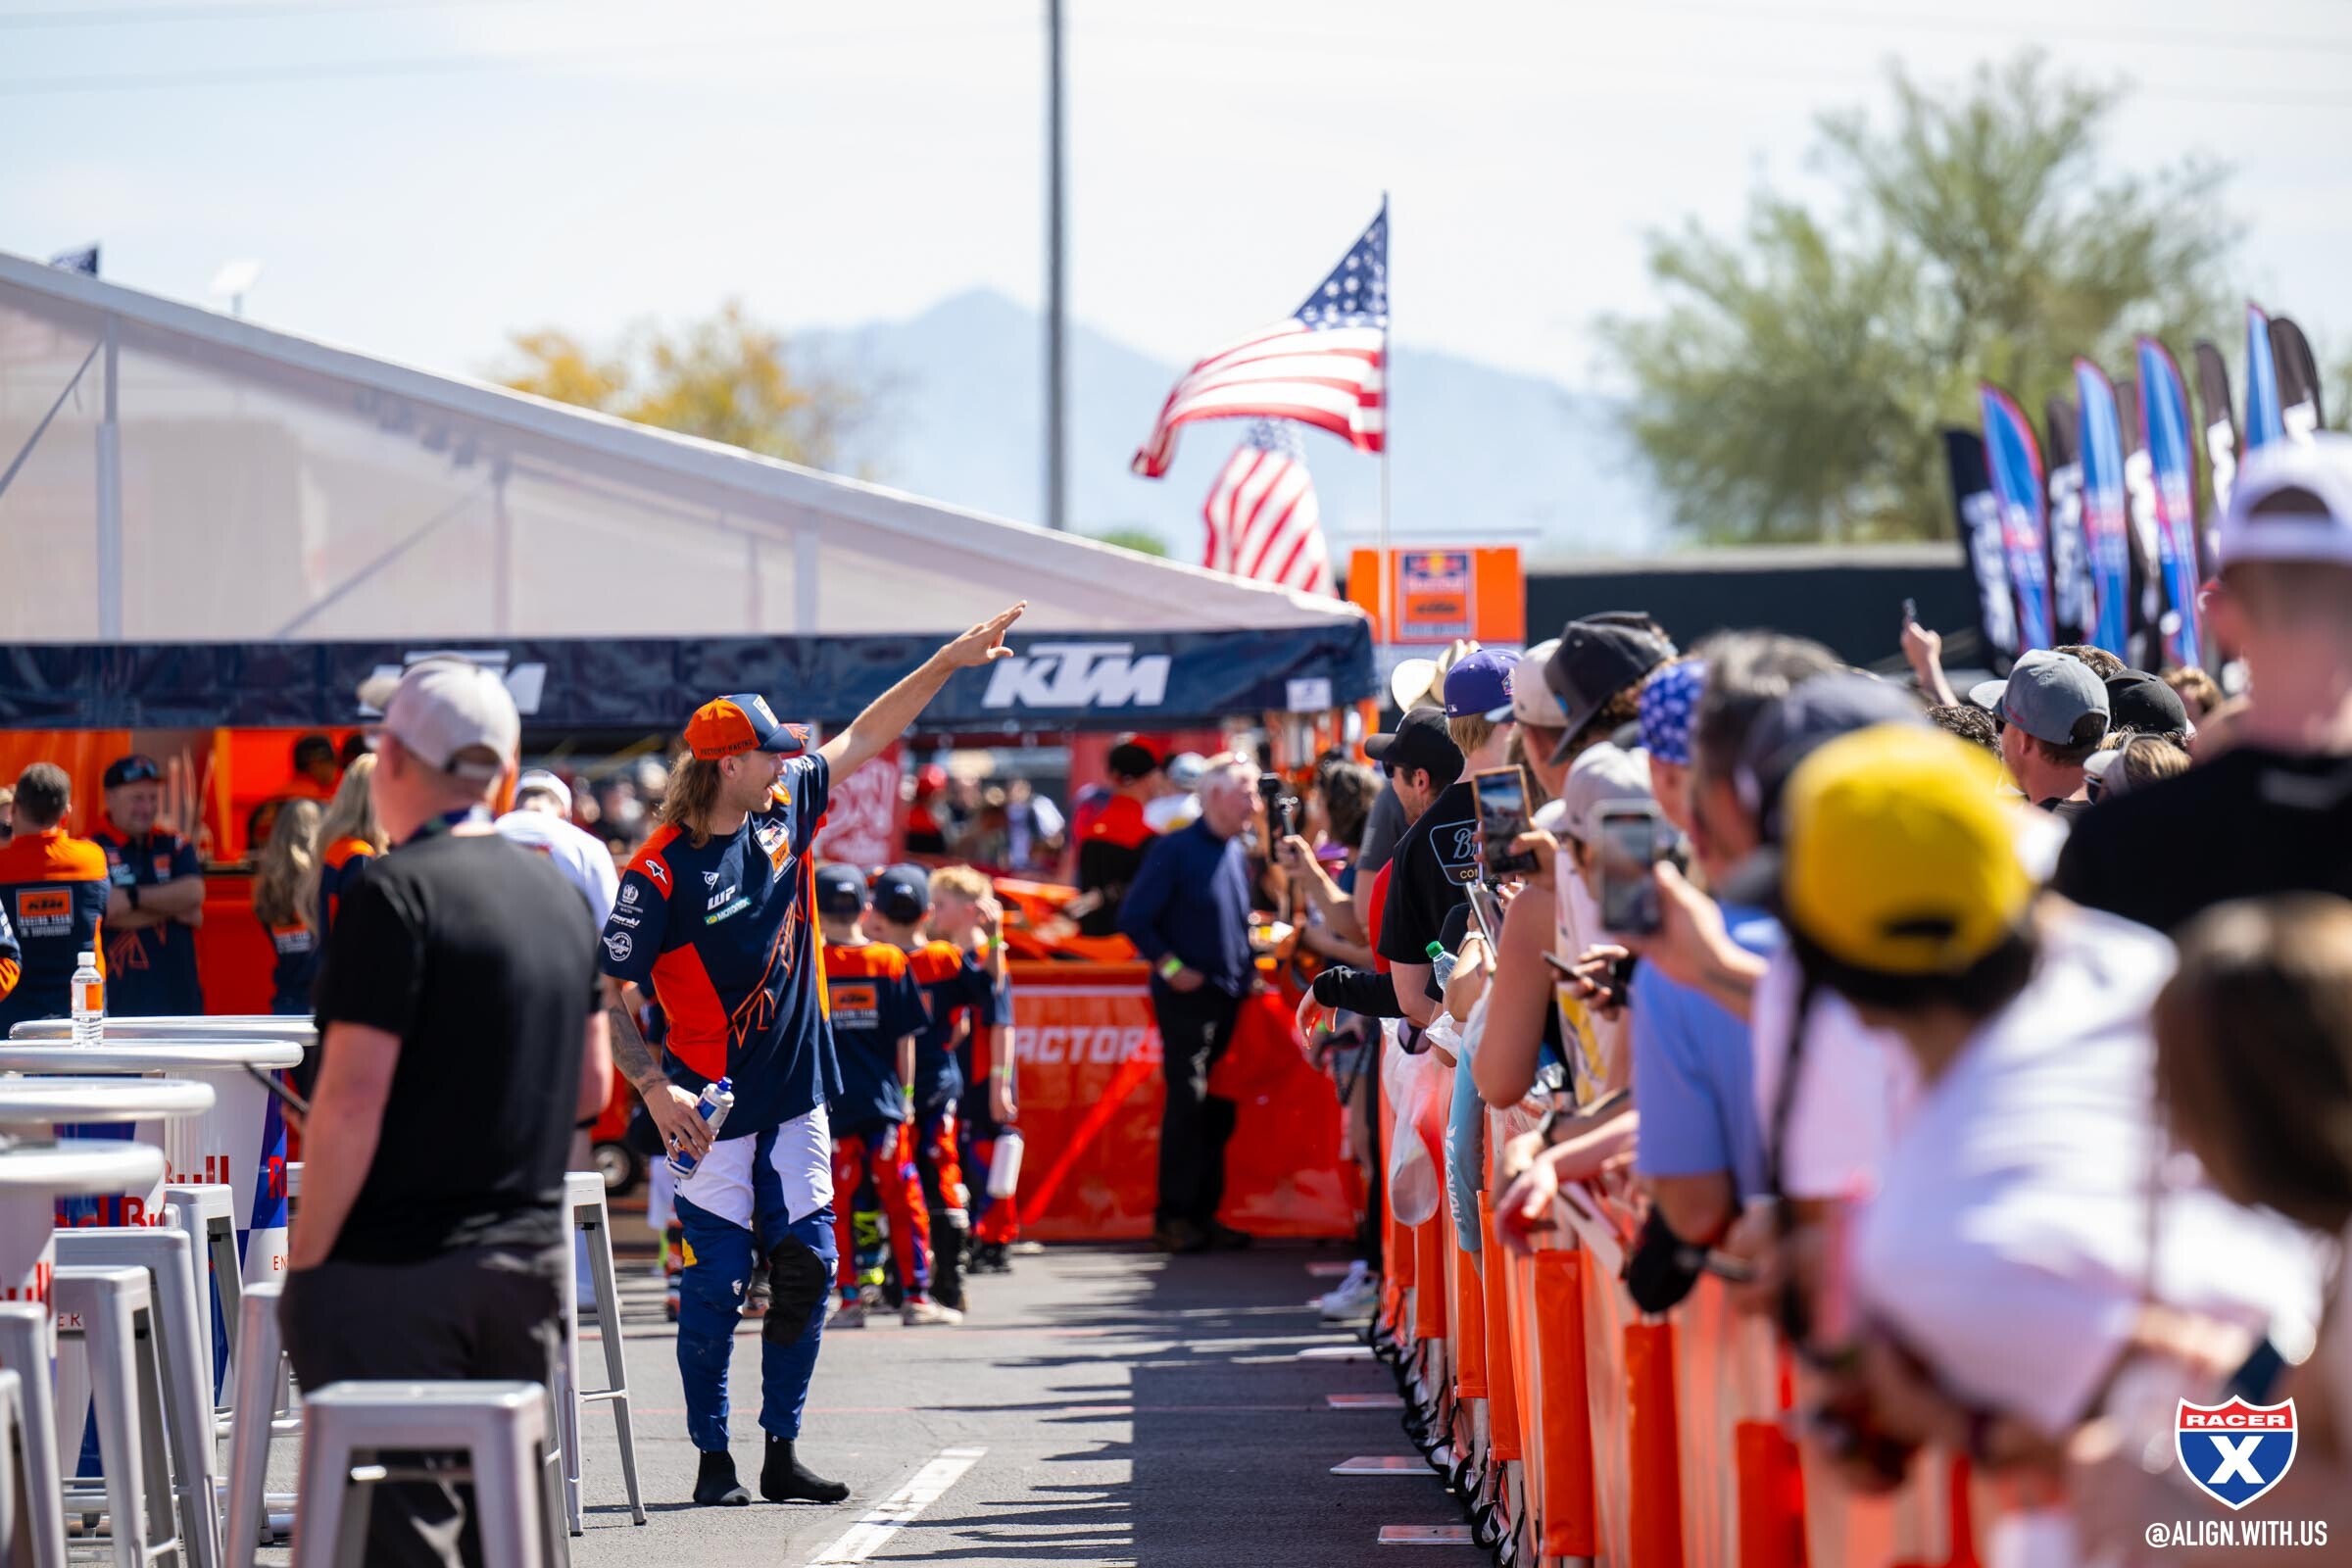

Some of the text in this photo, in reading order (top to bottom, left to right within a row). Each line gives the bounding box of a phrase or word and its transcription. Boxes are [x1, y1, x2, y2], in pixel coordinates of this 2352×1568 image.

[982, 642, 1172, 709] KTM
[707, 884, 737, 911] WP
[716, 898, 750, 921] MOTOREX
